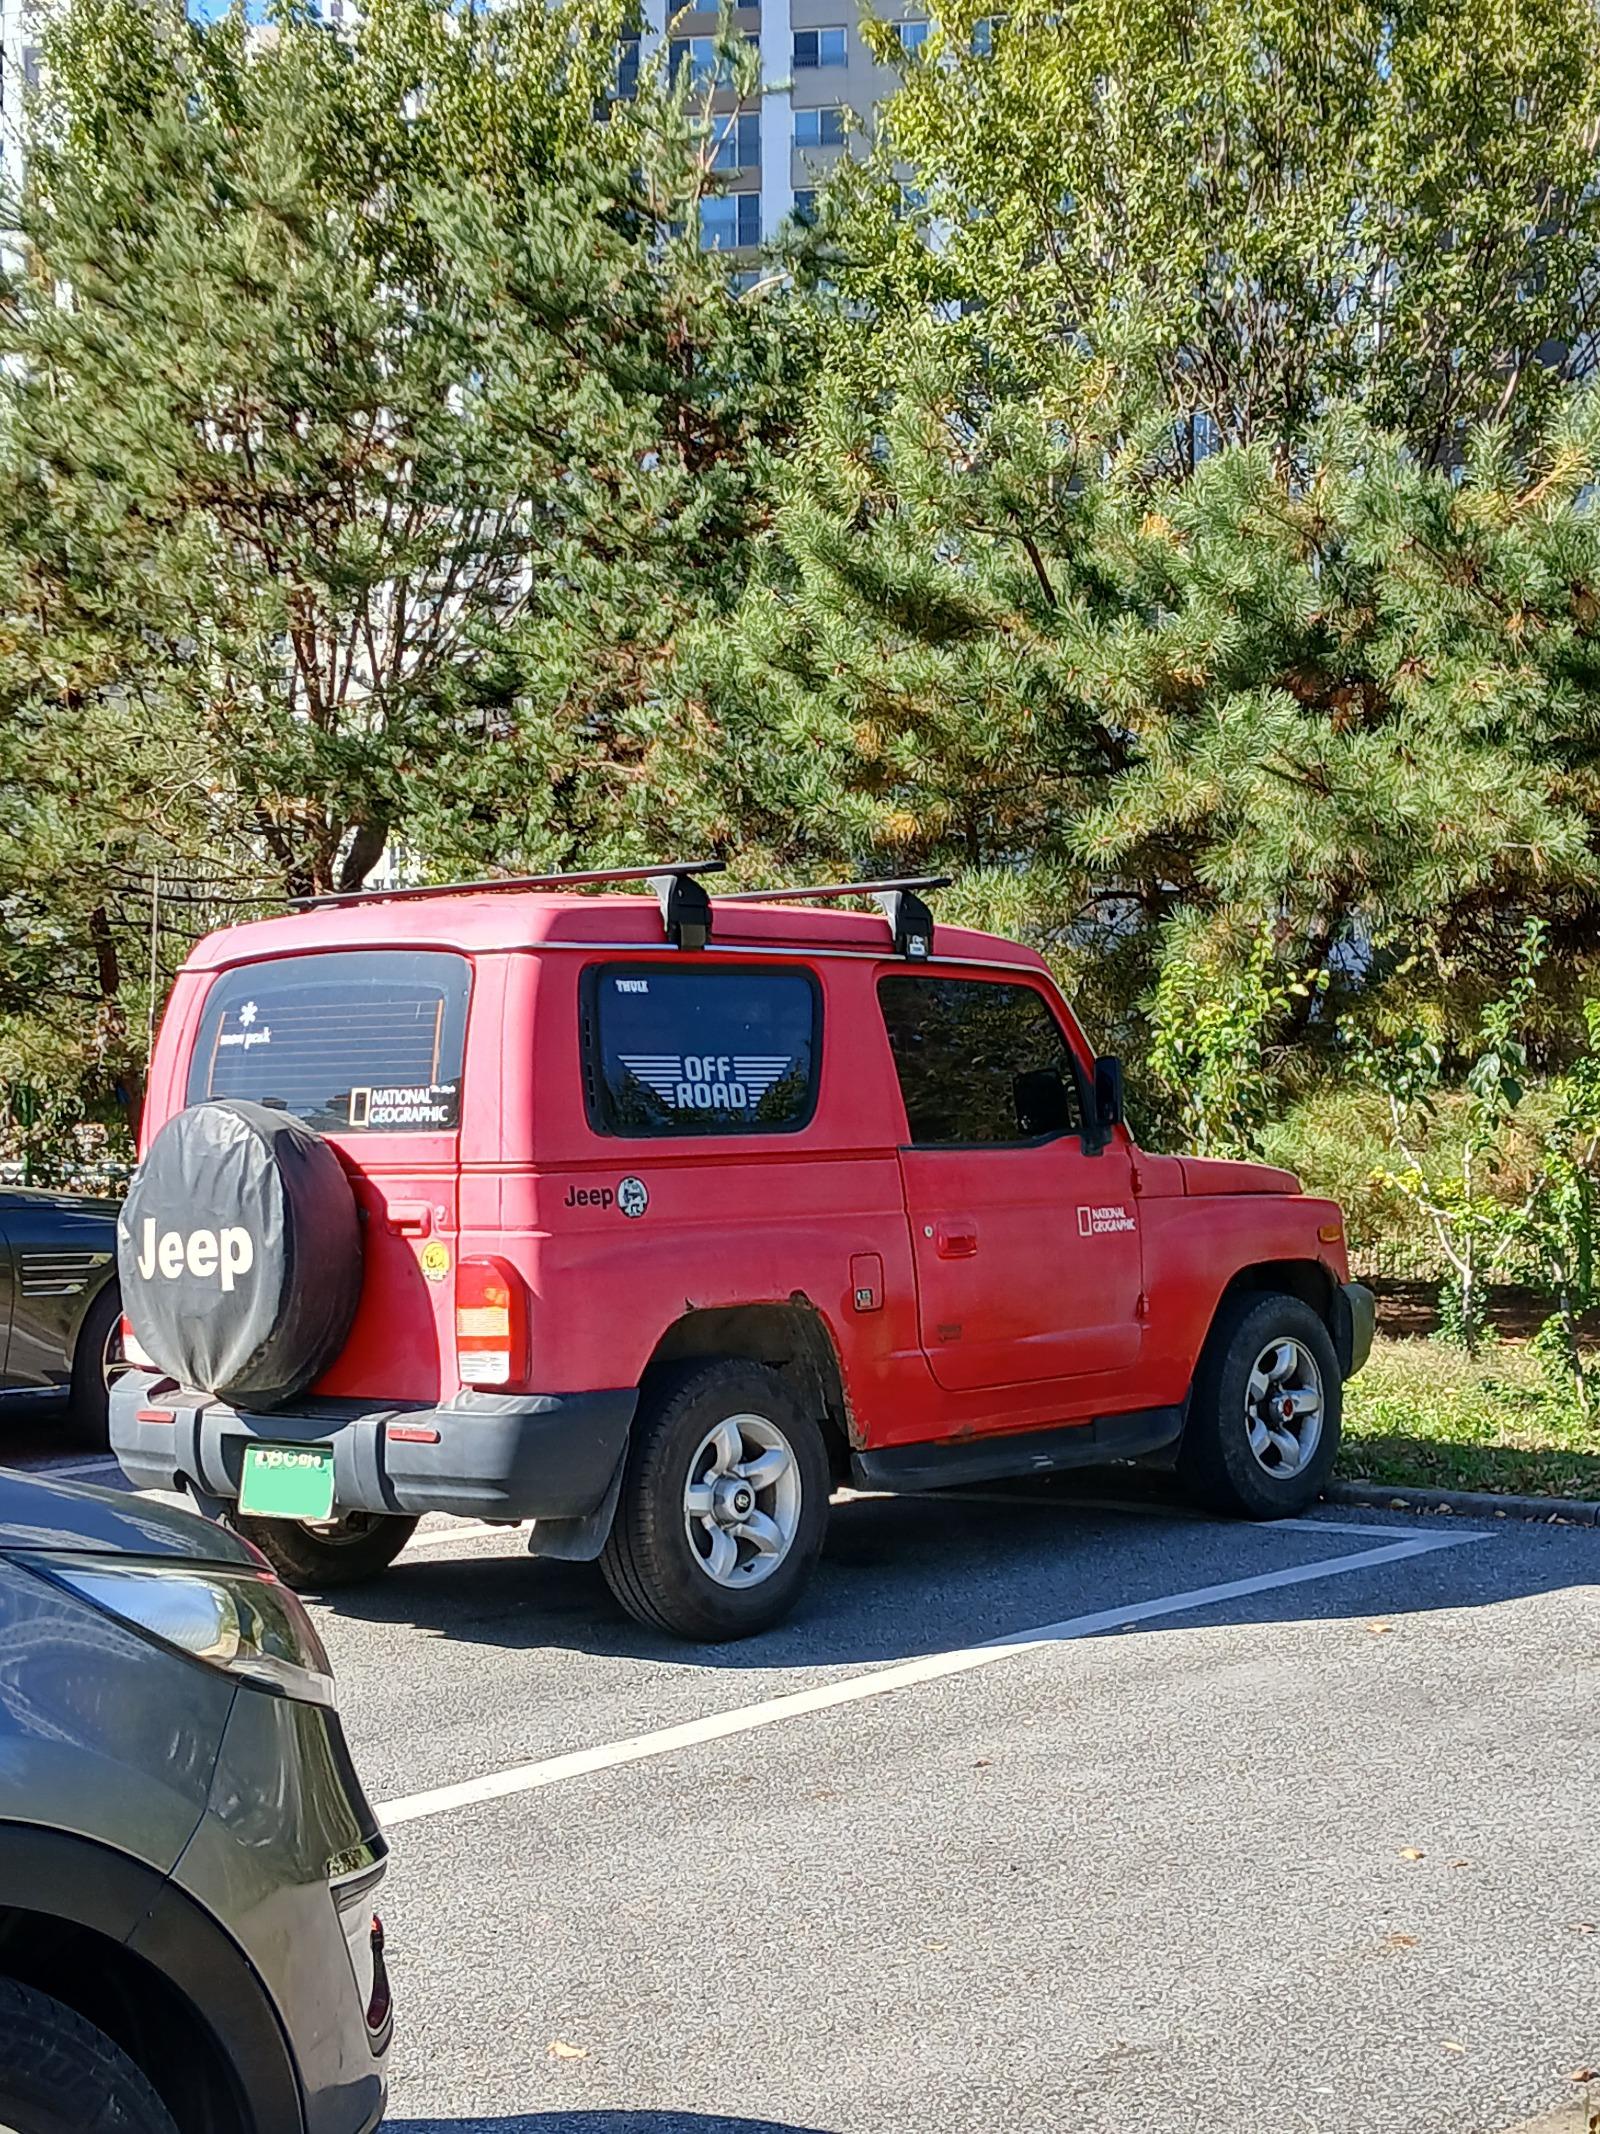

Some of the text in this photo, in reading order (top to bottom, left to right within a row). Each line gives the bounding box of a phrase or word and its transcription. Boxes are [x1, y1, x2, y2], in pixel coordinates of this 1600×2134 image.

[684, 1056, 731, 1081] OFF
[371, 1087, 433, 1106] NATIONAL
[676, 1083, 748, 1109] ROAD
[369, 1105, 449, 1124] GEOGRAPHIC
[564, 1185, 614, 1210] Jeep
[1092, 1206, 1126, 1220] NATIONAL
[137, 1217, 254, 1292] Jeep
